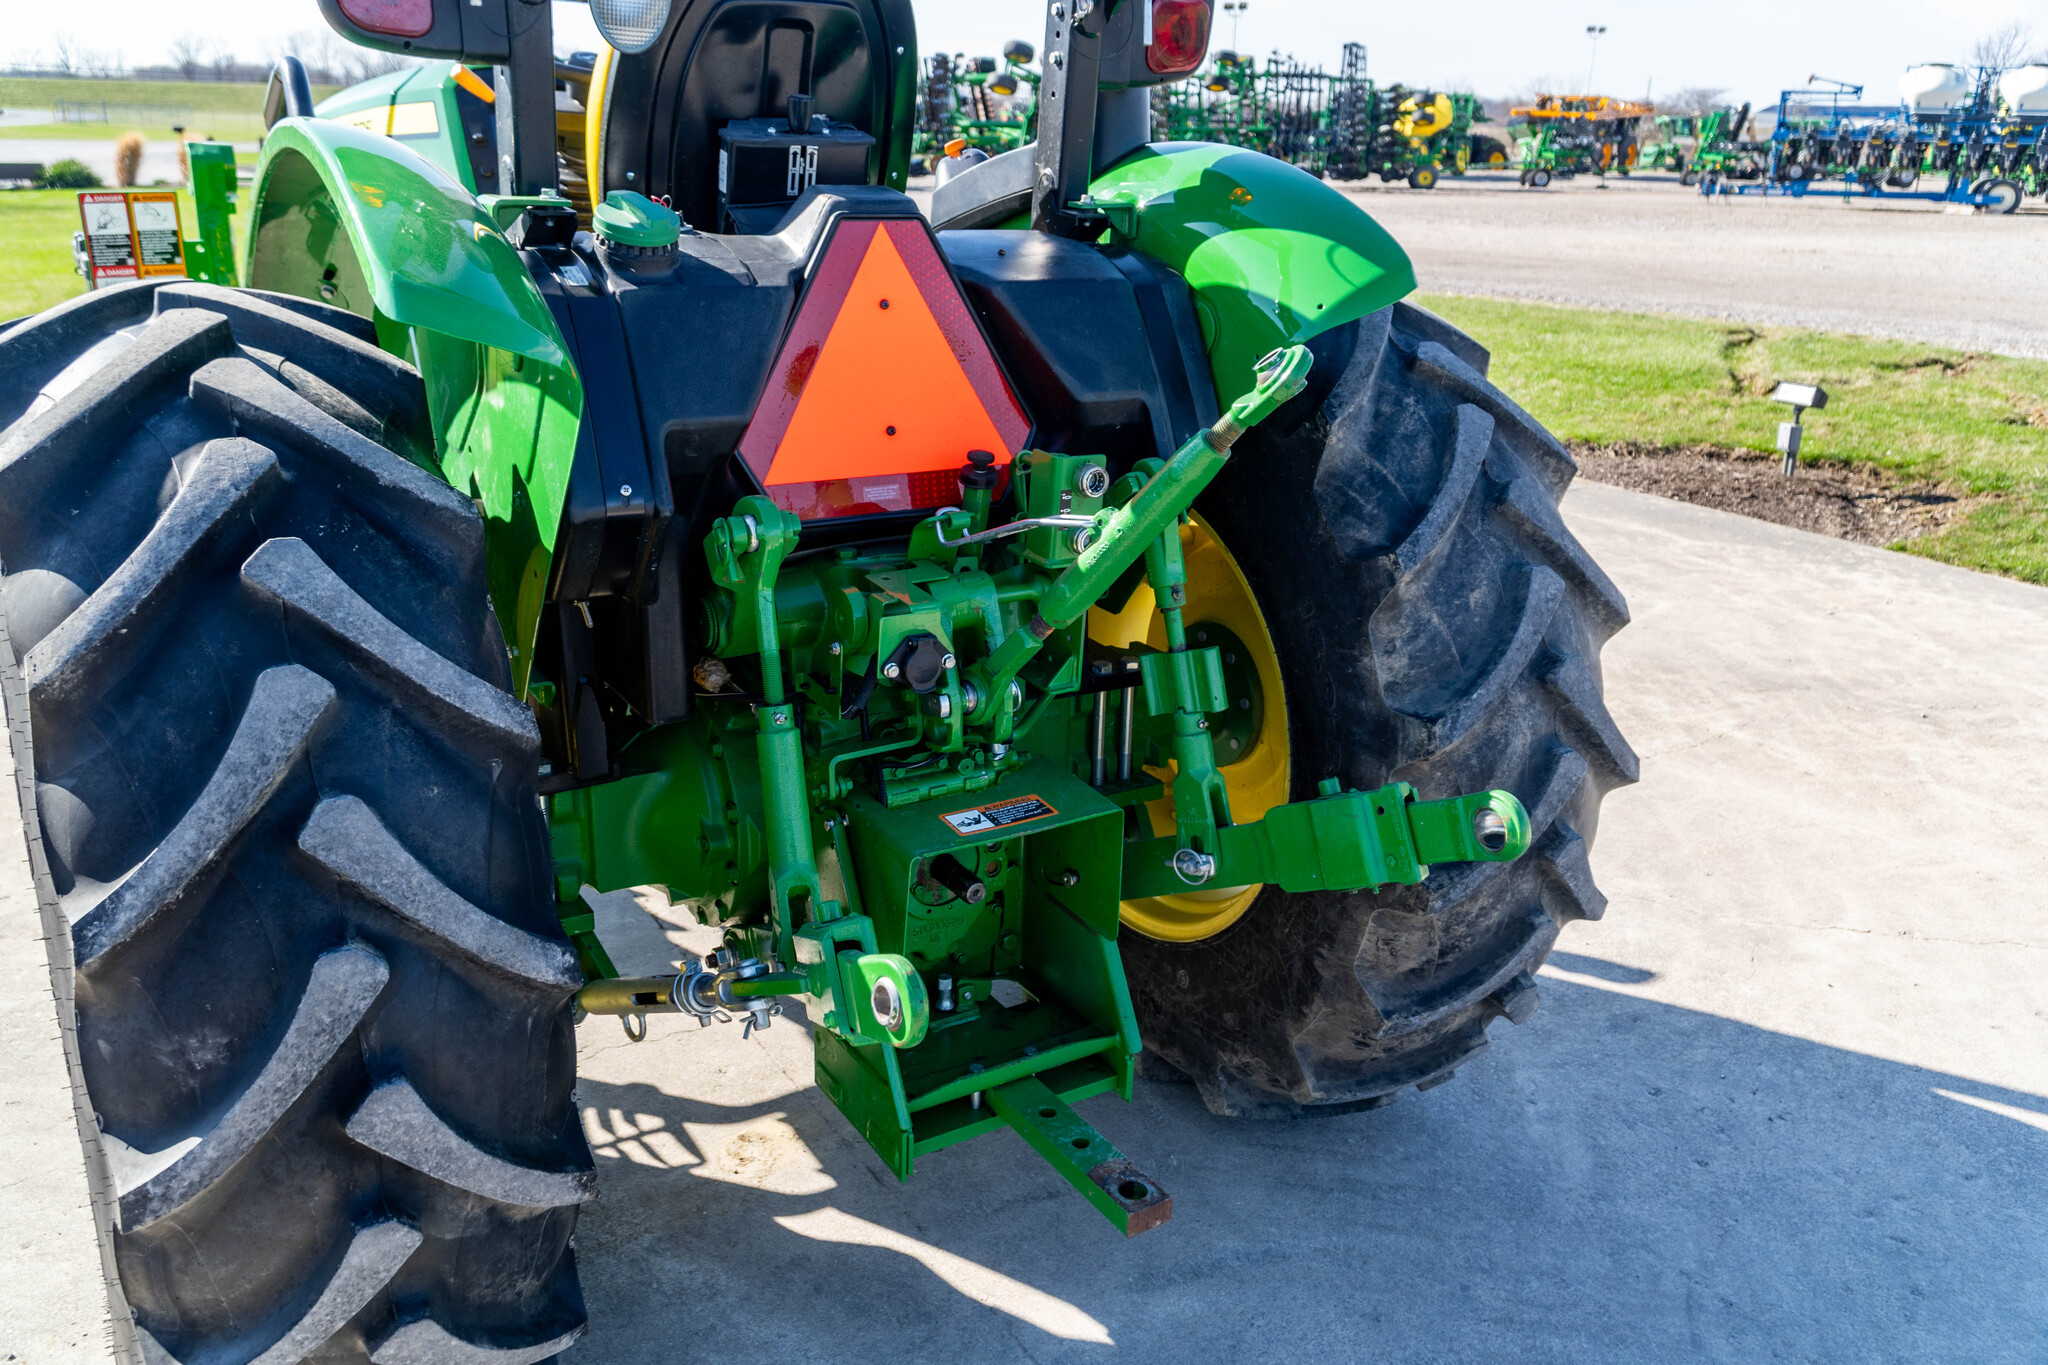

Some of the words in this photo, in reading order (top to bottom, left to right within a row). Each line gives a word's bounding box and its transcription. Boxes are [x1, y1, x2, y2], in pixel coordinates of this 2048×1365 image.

[94, 194, 124, 202] DANGER
[106, 268, 136, 276] DANGER
[992, 796, 1031, 809] WARNING
